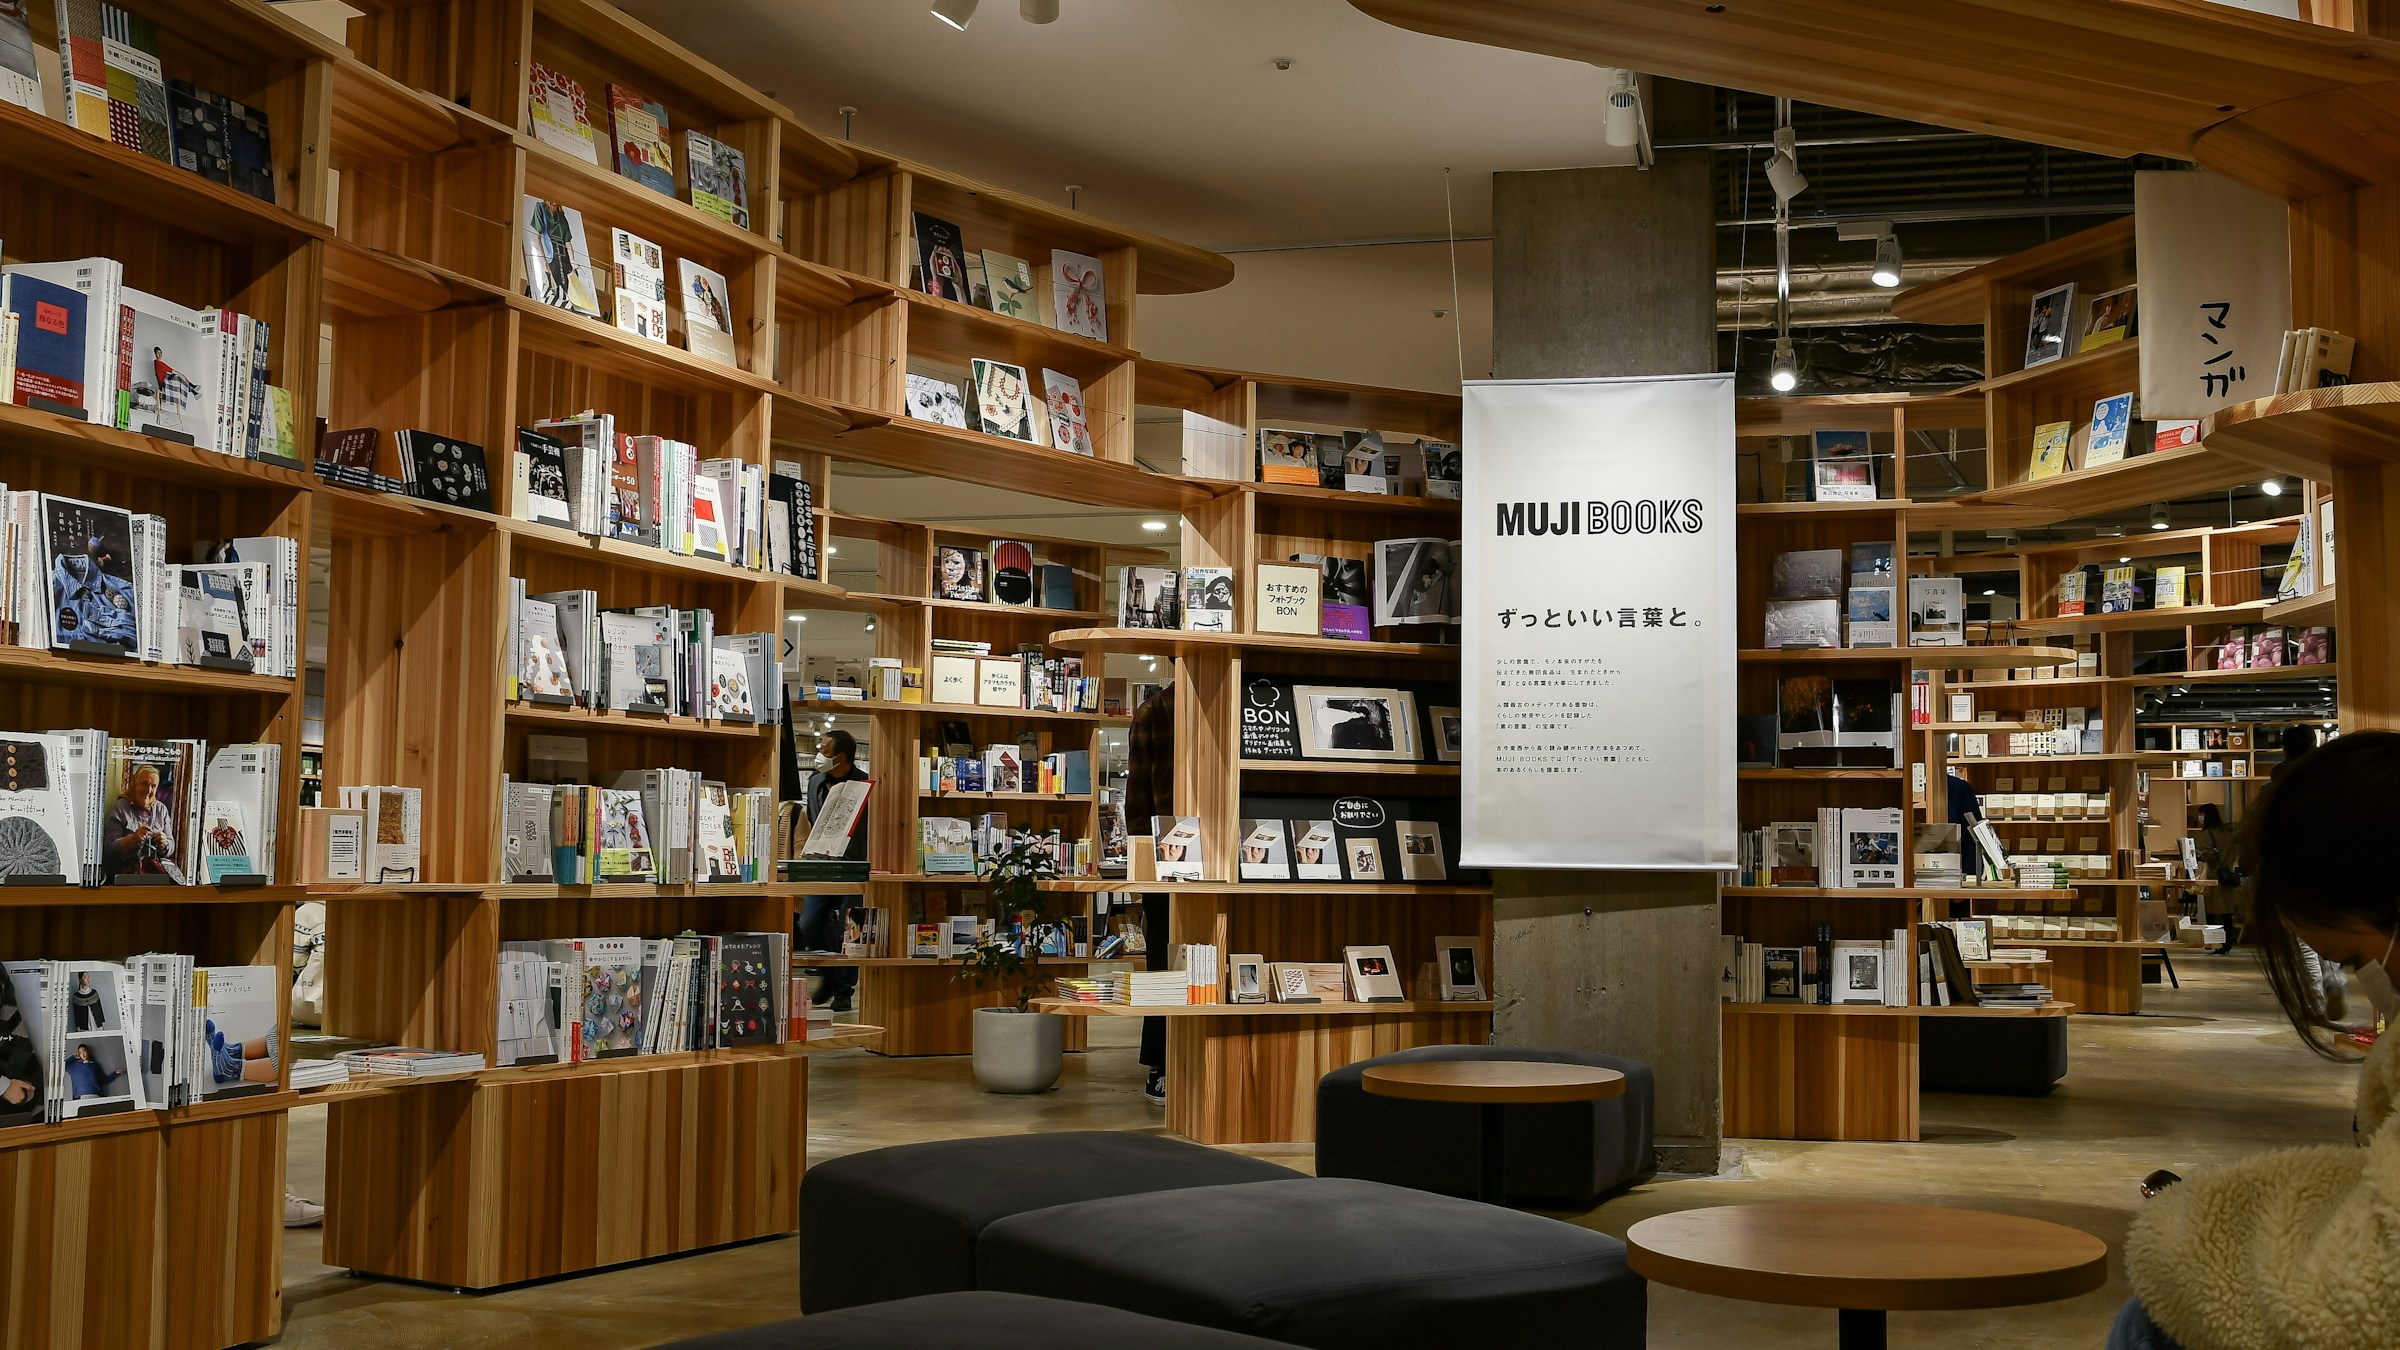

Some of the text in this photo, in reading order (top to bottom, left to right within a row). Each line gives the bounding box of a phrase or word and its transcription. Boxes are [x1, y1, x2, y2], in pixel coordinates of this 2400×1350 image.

[39, 314, 65, 329] 母なる色
[2199, 301, 2246, 398] マンガ
[1496, 498, 1704, 536] MUJI BOOKS
[243, 567, 253, 601] 背守り
[1266, 583, 1308, 594] おすすめの
[1268, 594, 1306, 606] フォトブック
[1276, 606, 1298, 616] BON
[1497, 607, 1702, 629] ずっといい言葉と。
[612, 643, 637, 651] クセサリー
[983, 679, 1017, 687] アタマもカラダも
[1243, 708, 1290, 725] BON
[111, 745, 182, 756] エストニアの手編みこもの
[28, 795, 34, 804] of
[10, 804, 46, 817] Knitting
[1339, 801, 1368, 810] ご自由に
[208, 986, 252, 994] どもニットくつした
